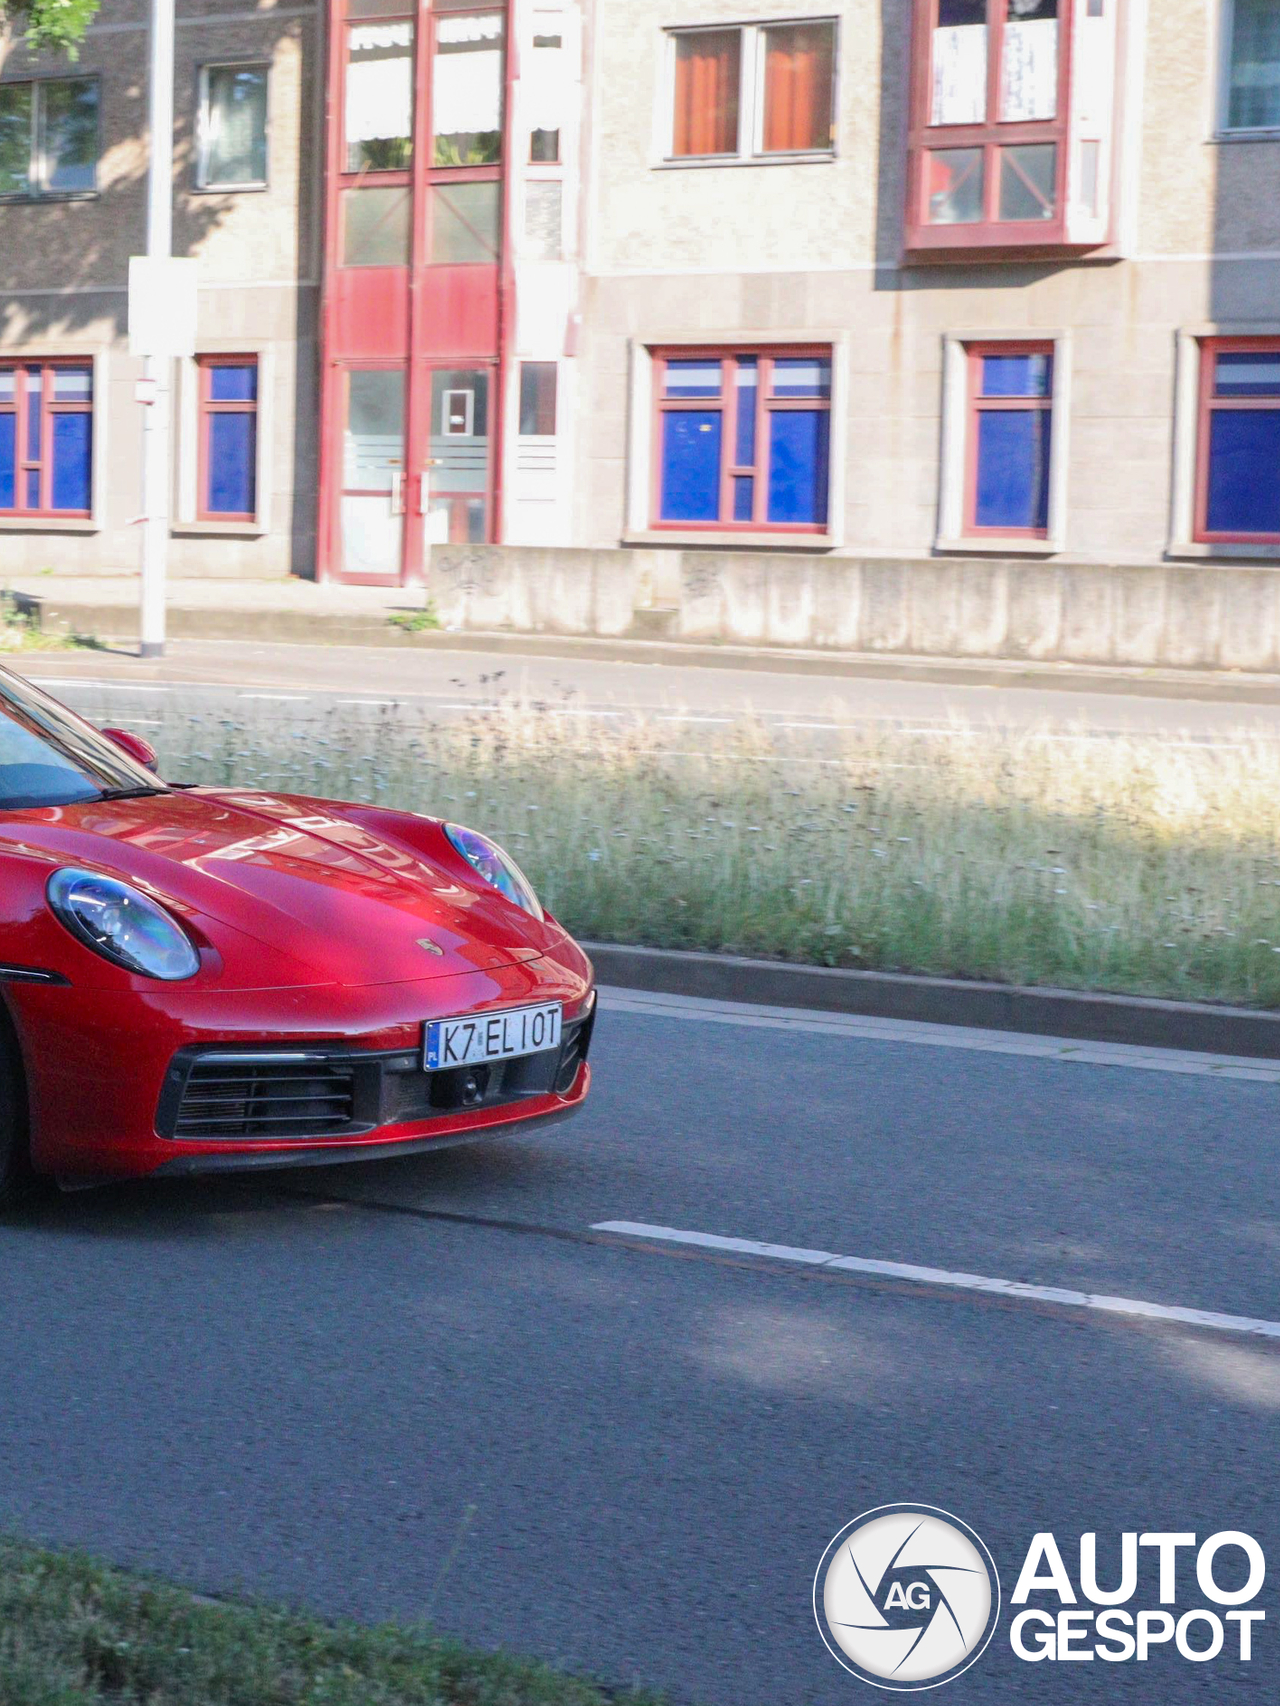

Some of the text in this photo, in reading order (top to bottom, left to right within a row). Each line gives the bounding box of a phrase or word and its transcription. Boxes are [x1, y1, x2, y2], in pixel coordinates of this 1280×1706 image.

[444, 1008, 559, 1062] K7 ELIOT
[427, 1052, 438, 1062] PL
